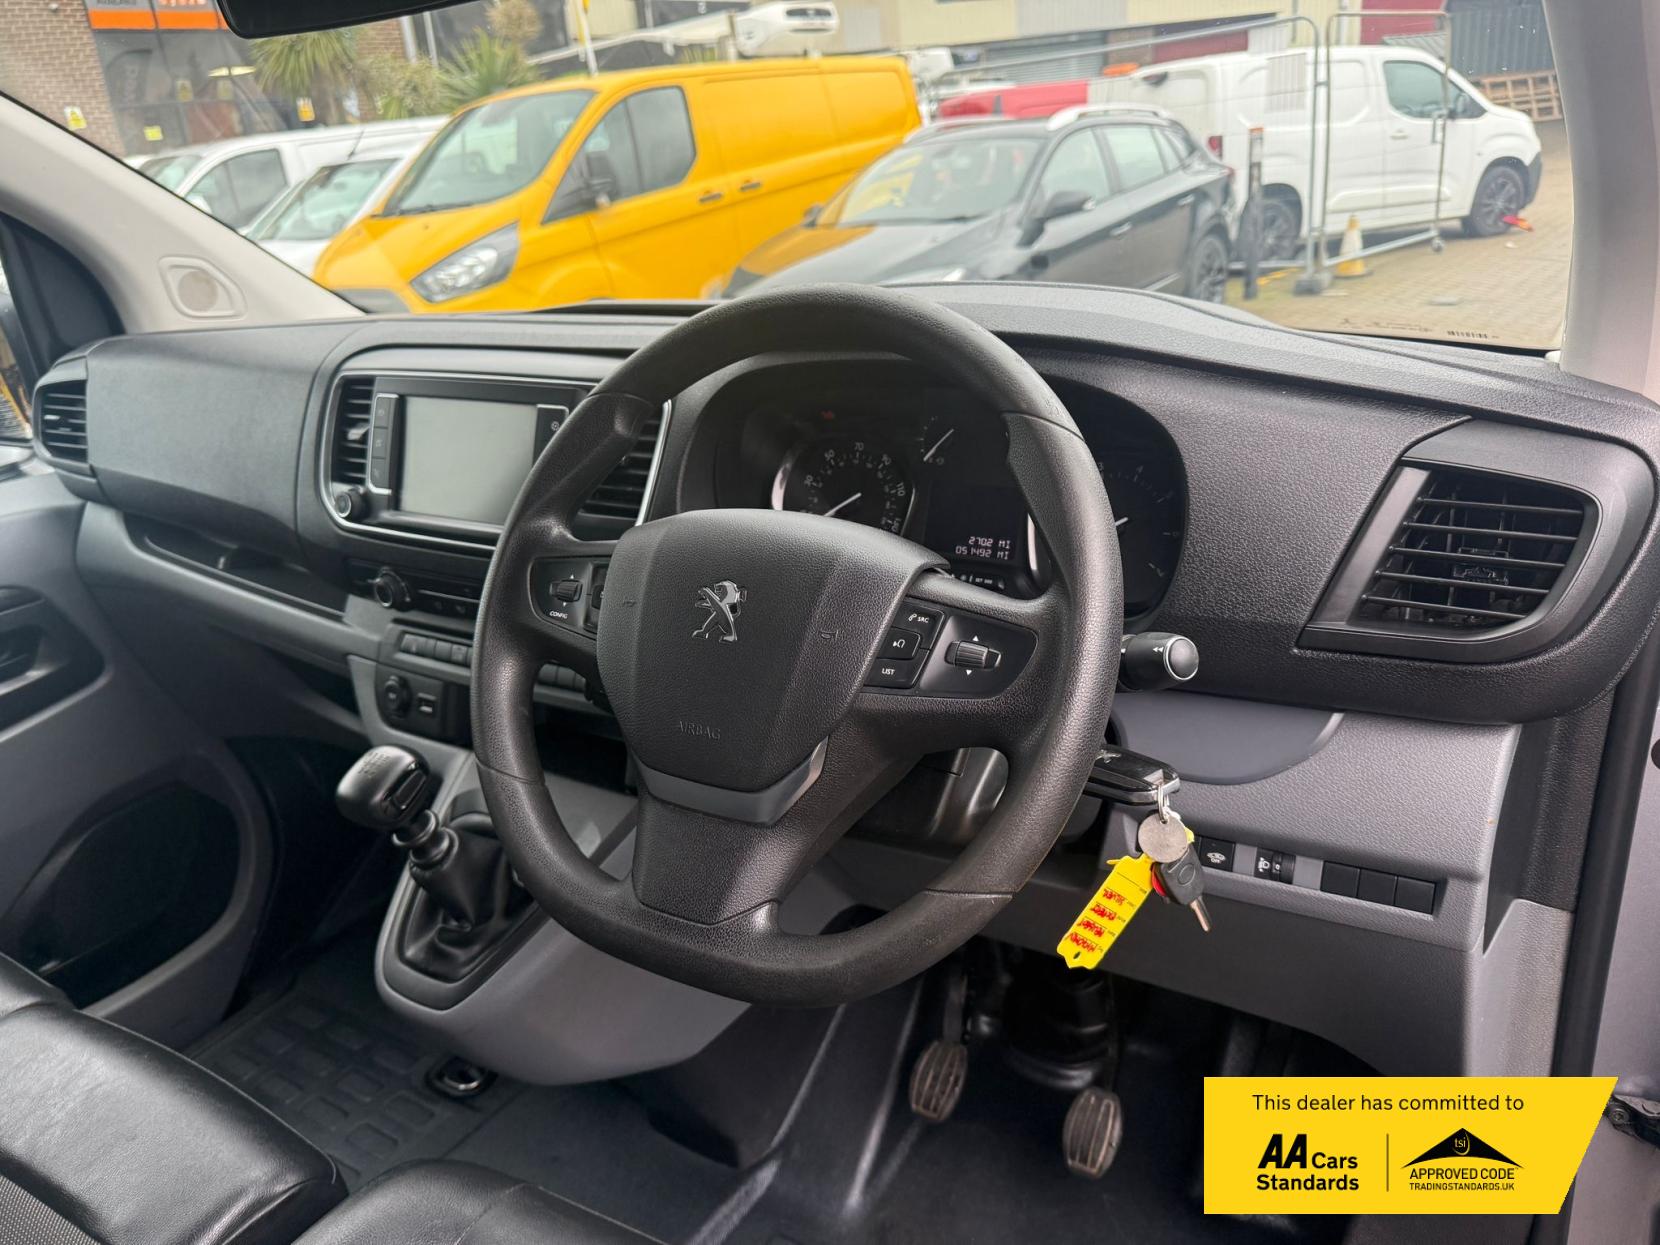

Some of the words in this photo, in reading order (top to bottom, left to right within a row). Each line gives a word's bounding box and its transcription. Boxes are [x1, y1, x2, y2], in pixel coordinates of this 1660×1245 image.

[968, 536, 994, 547] 2702
[998, 540, 1011, 549] MI
[955, 545, 992, 558] 051492
[996, 551, 1010, 560] MI
[549, 610, 568, 619] CONFIG
[917, 616, 930, 624] SRC
[881, 667, 896, 676] LIST
